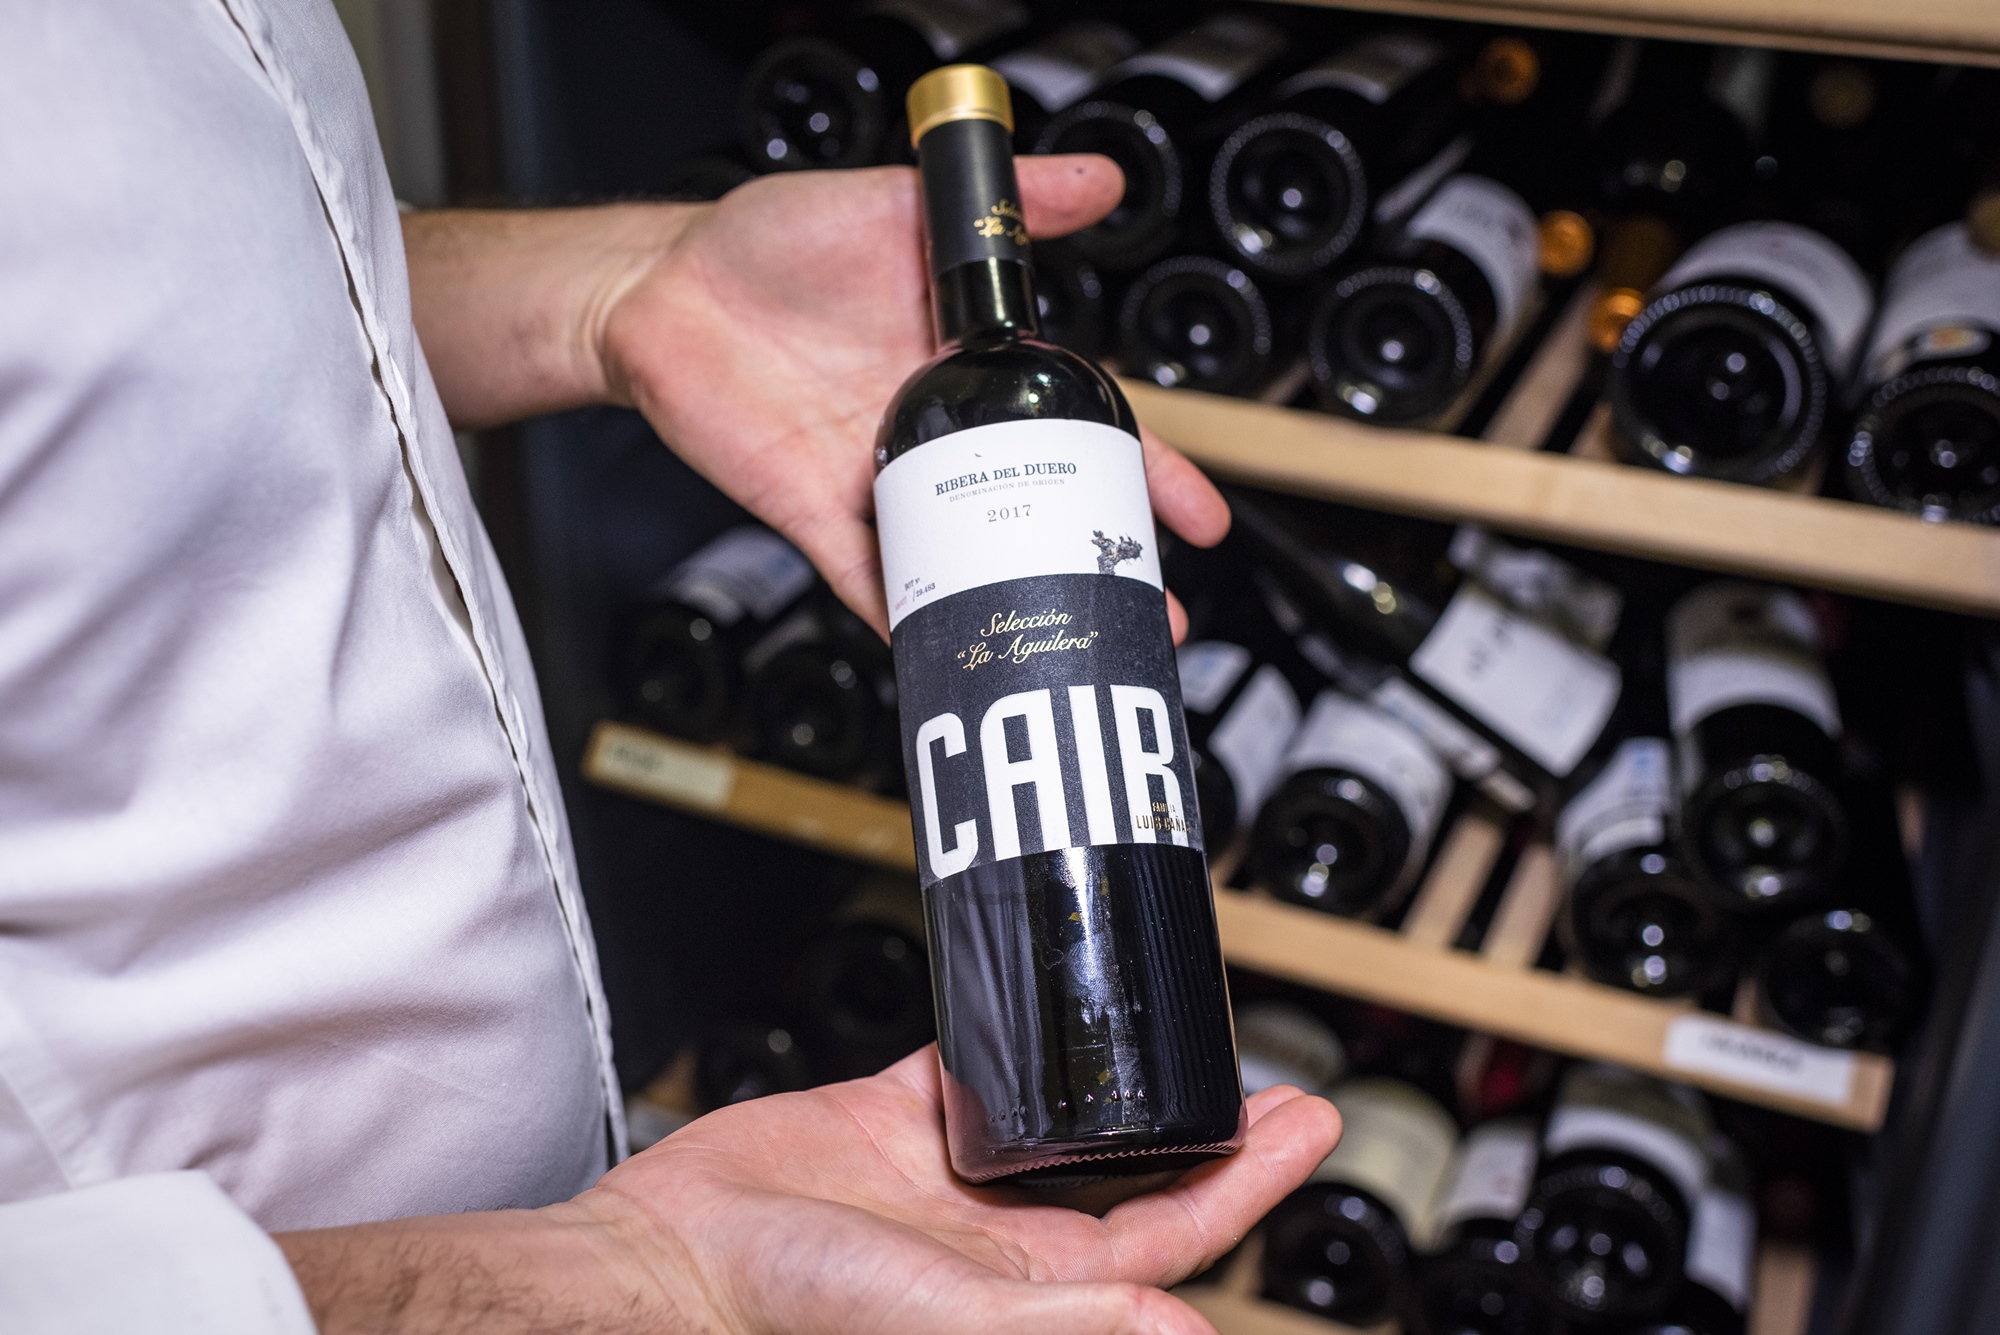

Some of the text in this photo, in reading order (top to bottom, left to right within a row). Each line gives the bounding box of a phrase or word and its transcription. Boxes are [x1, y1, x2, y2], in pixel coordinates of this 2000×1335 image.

[935, 462, 1077, 496] RIBERA DEL DUERO
[949, 478, 1065, 502] DENOMINACIÓN DE ORIGEN
[987, 504, 1031, 523] 2017
[980, 608, 1072, 637] Selección
[916, 684, 1189, 879] CAIR
[1135, 815, 1162, 831] LUIS
